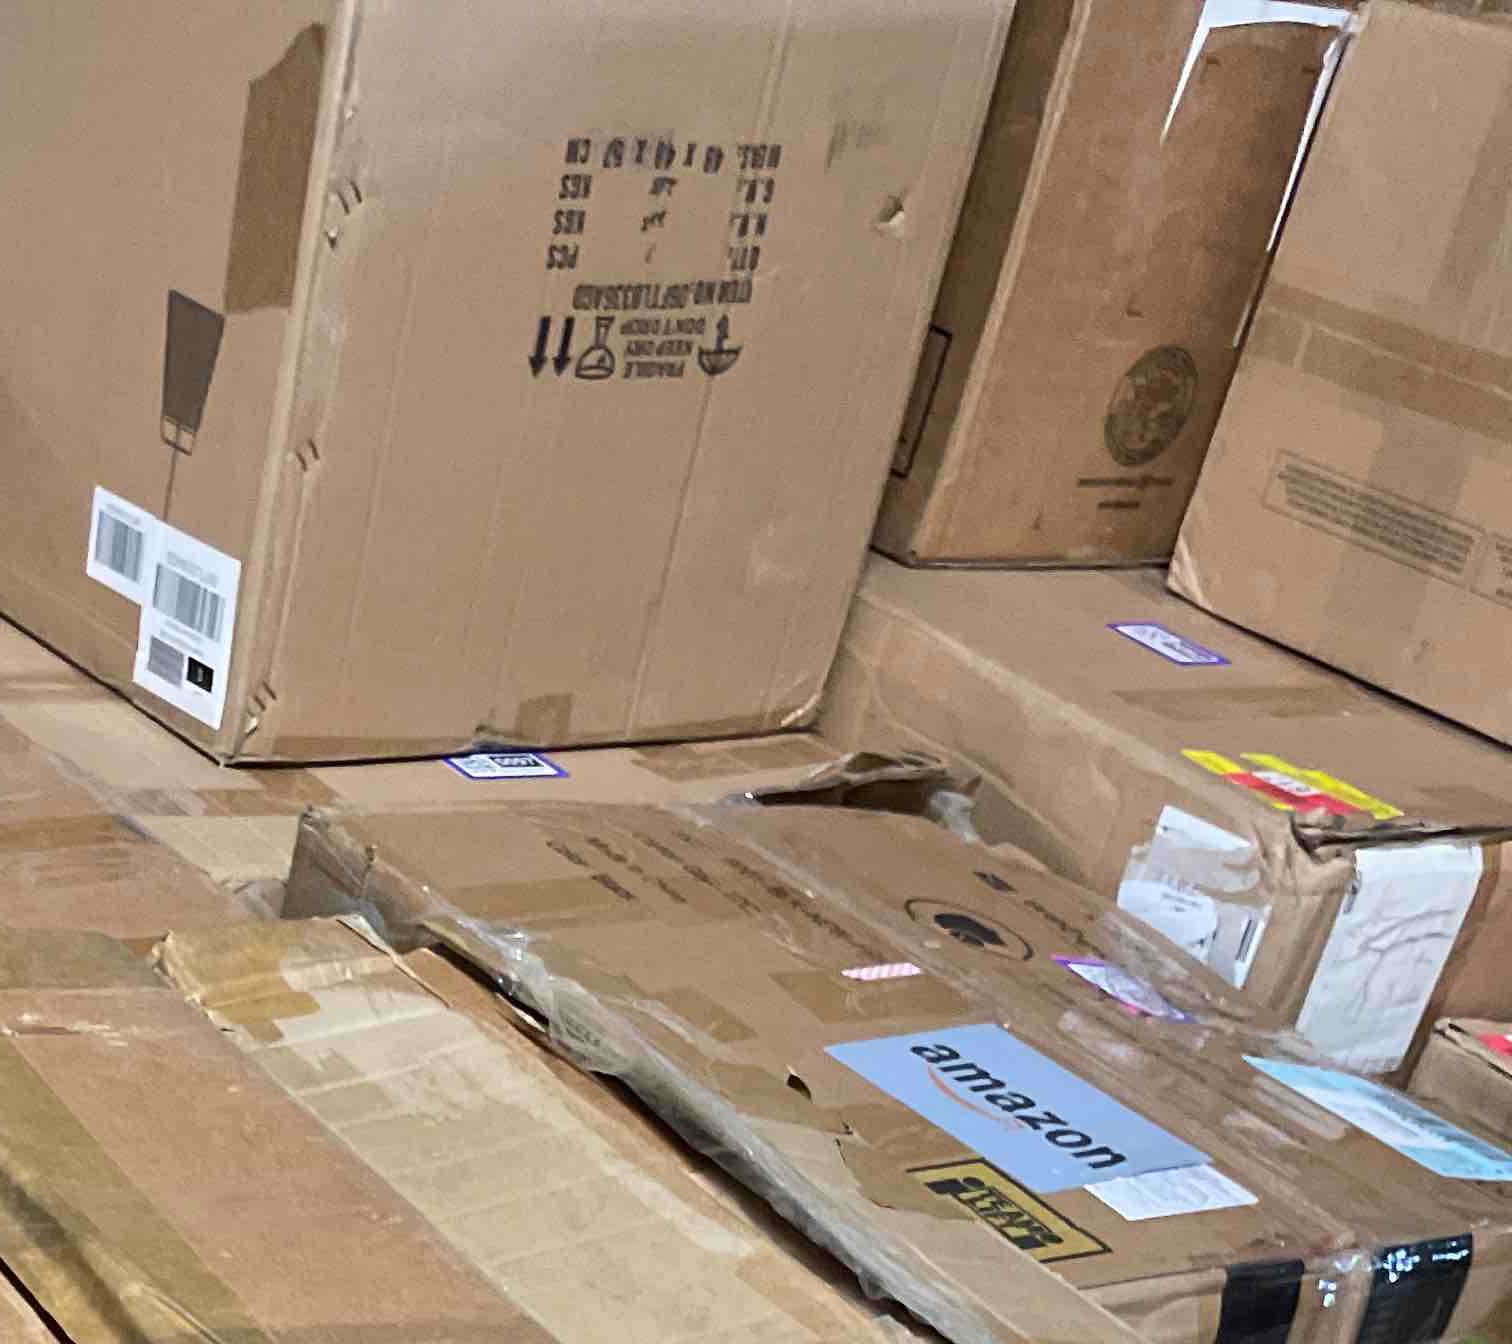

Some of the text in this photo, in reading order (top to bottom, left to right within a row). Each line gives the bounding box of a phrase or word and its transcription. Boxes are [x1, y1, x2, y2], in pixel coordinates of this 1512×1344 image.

[565, 139, 590, 164] CM
[559, 174, 592, 199] KGS
[552, 210, 585, 234] KGS
[546, 245, 579, 269] PCS
[620, 318, 661, 335] DROP
[624, 340, 694, 356] KEEP DRY
[622, 361, 685, 378] FRAGILE
[910, 1044, 1127, 1168] amazon
